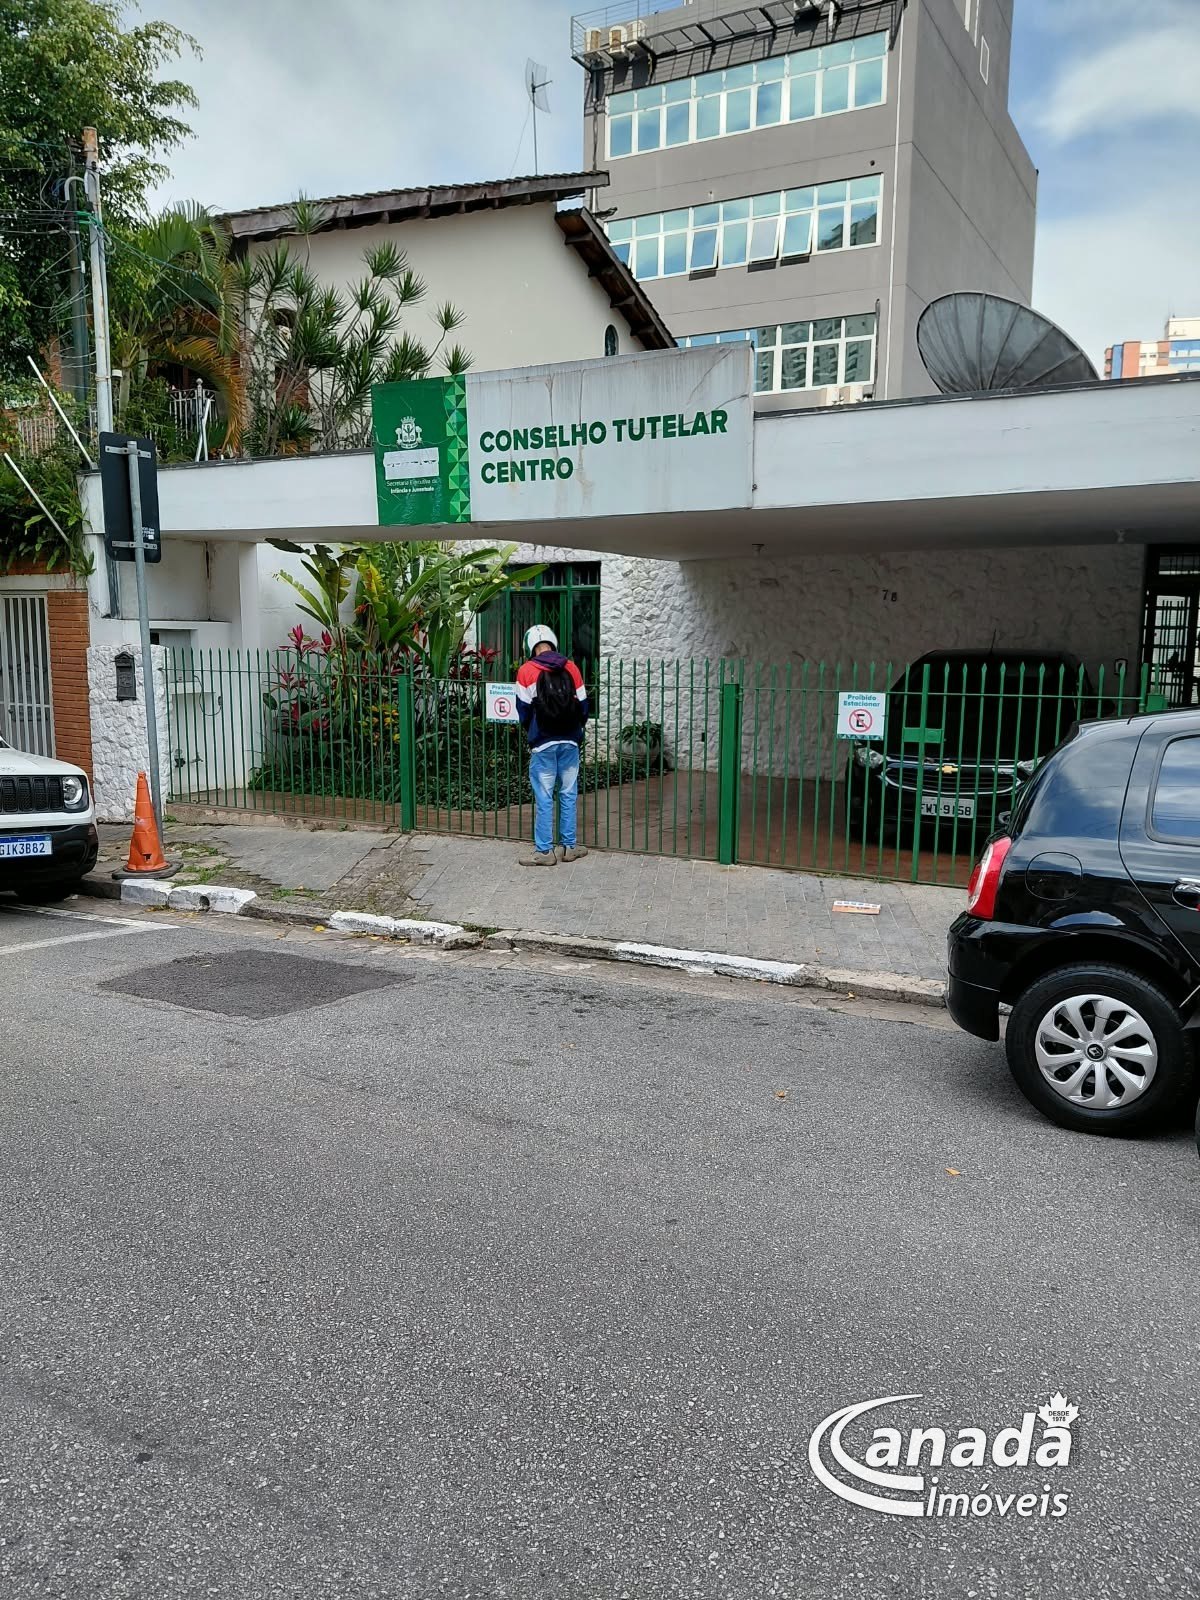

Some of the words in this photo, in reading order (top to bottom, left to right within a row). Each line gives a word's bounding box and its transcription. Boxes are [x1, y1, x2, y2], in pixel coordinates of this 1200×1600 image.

[479, 420, 607, 453] CONSELHO
[612, 409, 728, 442] TUTELAR
[481, 456, 574, 484] CENTRO
[0, 842, 46, 855] GIK3B82
